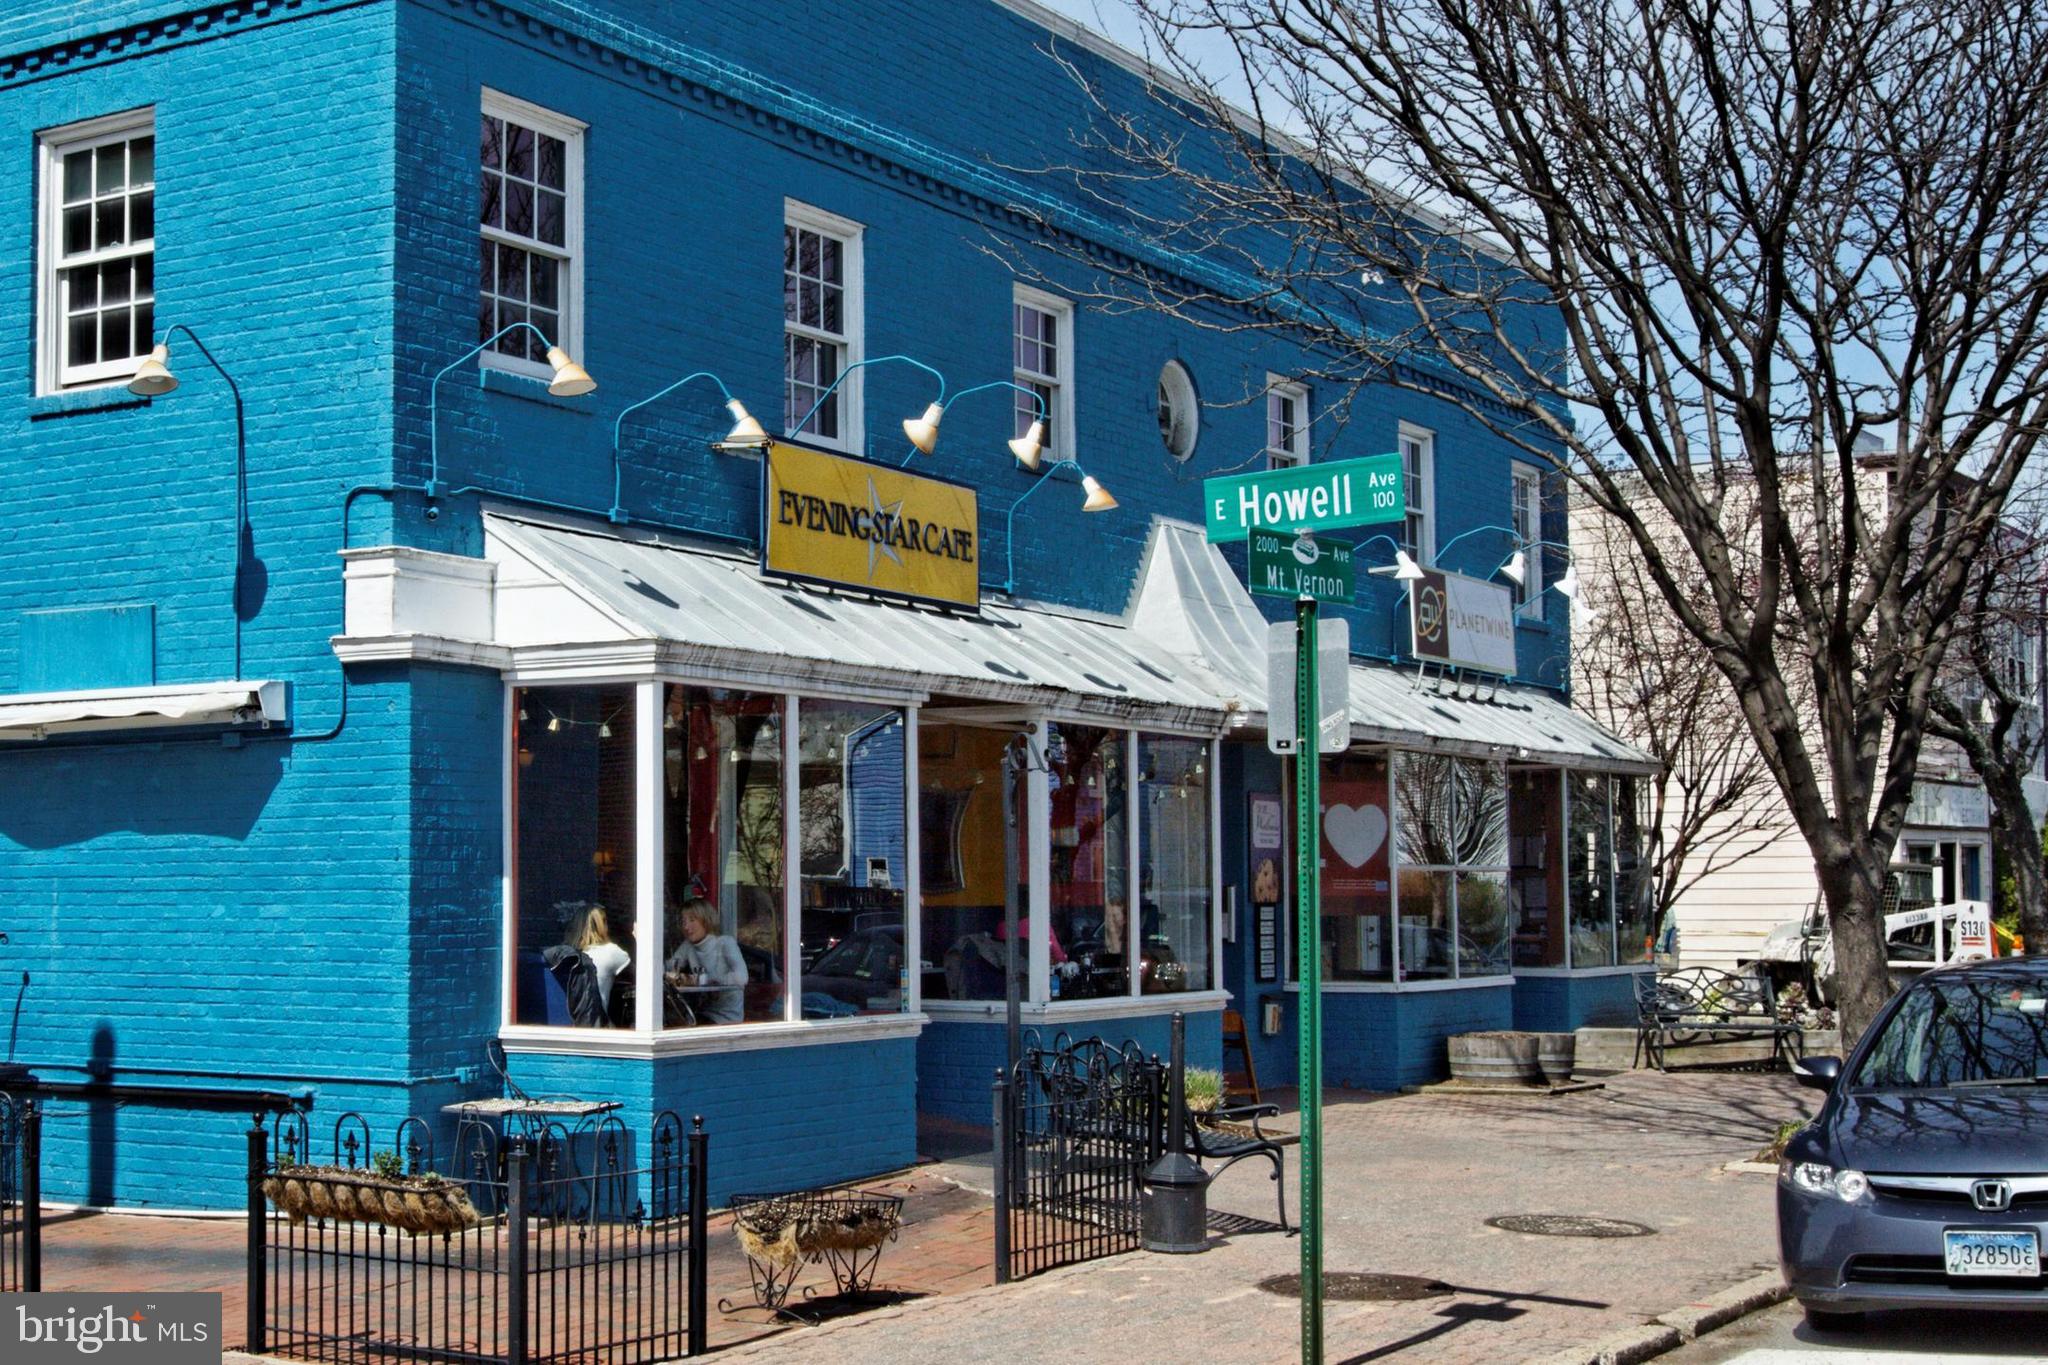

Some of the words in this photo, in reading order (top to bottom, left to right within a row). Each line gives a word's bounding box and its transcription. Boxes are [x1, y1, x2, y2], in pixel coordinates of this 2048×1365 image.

[1215, 499, 1226, 521] E
[1239, 473, 1352, 528] Howell
[1369, 472, 1396, 488] Ave
[1372, 491, 1395, 509] 100
[1256, 535, 1279, 554] 2000
[1333, 546, 1350, 563] Ave
[1267, 564, 1289, 591] Mt.
[1294, 567, 1344, 597] Vernon
[1961, 920, 1985, 936] S130
